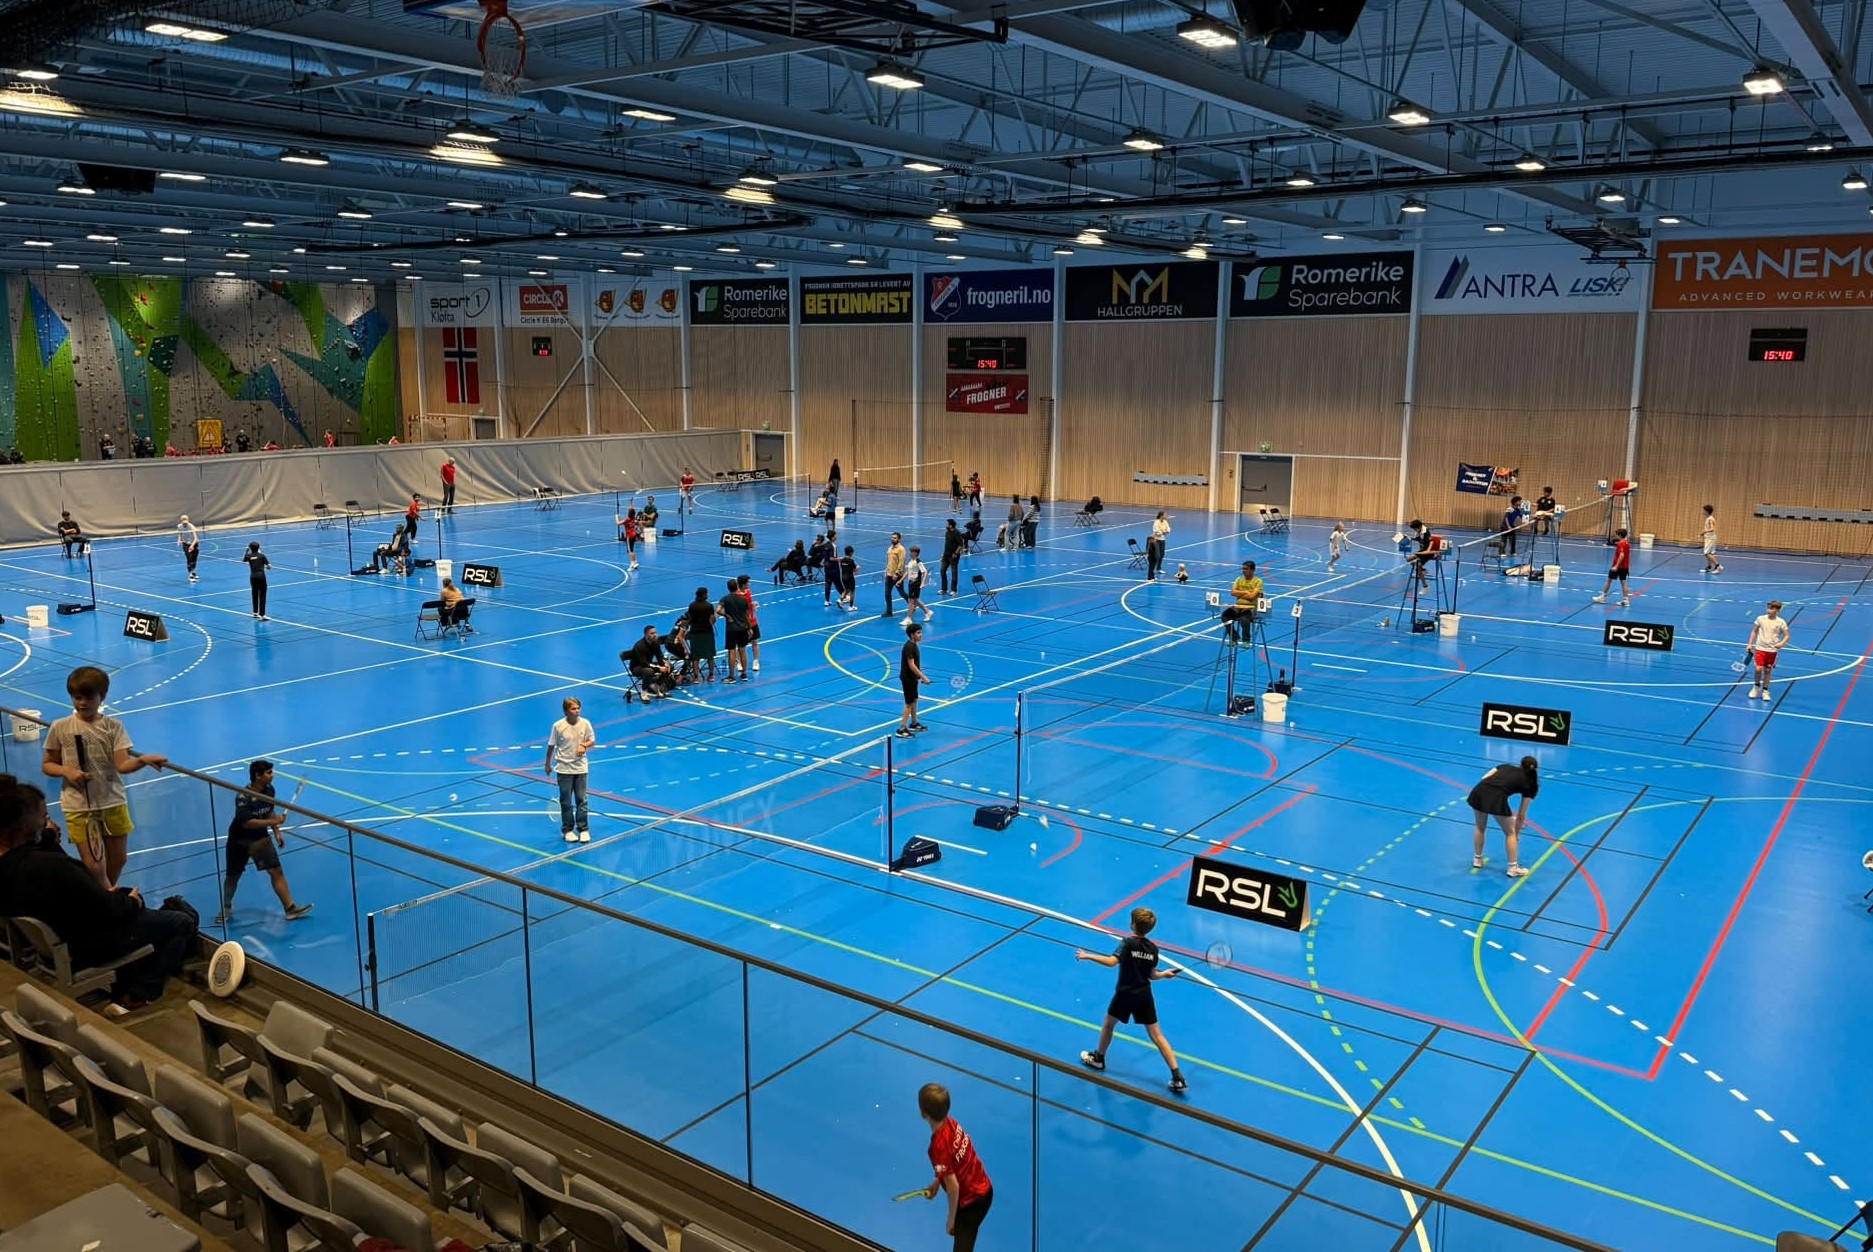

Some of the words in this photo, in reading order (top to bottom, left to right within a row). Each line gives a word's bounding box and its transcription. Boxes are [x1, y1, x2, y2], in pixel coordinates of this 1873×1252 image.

[1291, 261, 1404, 284] Romerike
[724, 285, 787, 301] Romerike
[1462, 272, 1560, 298] ANTRA
[805, 292, 911, 314] BETONMAST
[967, 285, 1051, 308] frogneril.no
[1288, 286, 1401, 311] Sparebank
[1679, 291, 1766, 301] ADVANCED
[723, 302, 787, 320] Sparebank
[1097, 304, 1183, 317] HALLGRUPPEN
[978, 360, 997, 368] 15:40
[1764, 351, 1794, 360] 15:40
[966, 386, 1007, 405] FROGNER
[722, 533, 747, 546] RSL
[464, 568, 492, 583] RSL
[126, 616, 153, 637] RSL
[1608, 625, 1663, 645] RSL
[1486, 710, 1557, 738] RSL
[1196, 868, 1286, 918] RSL
